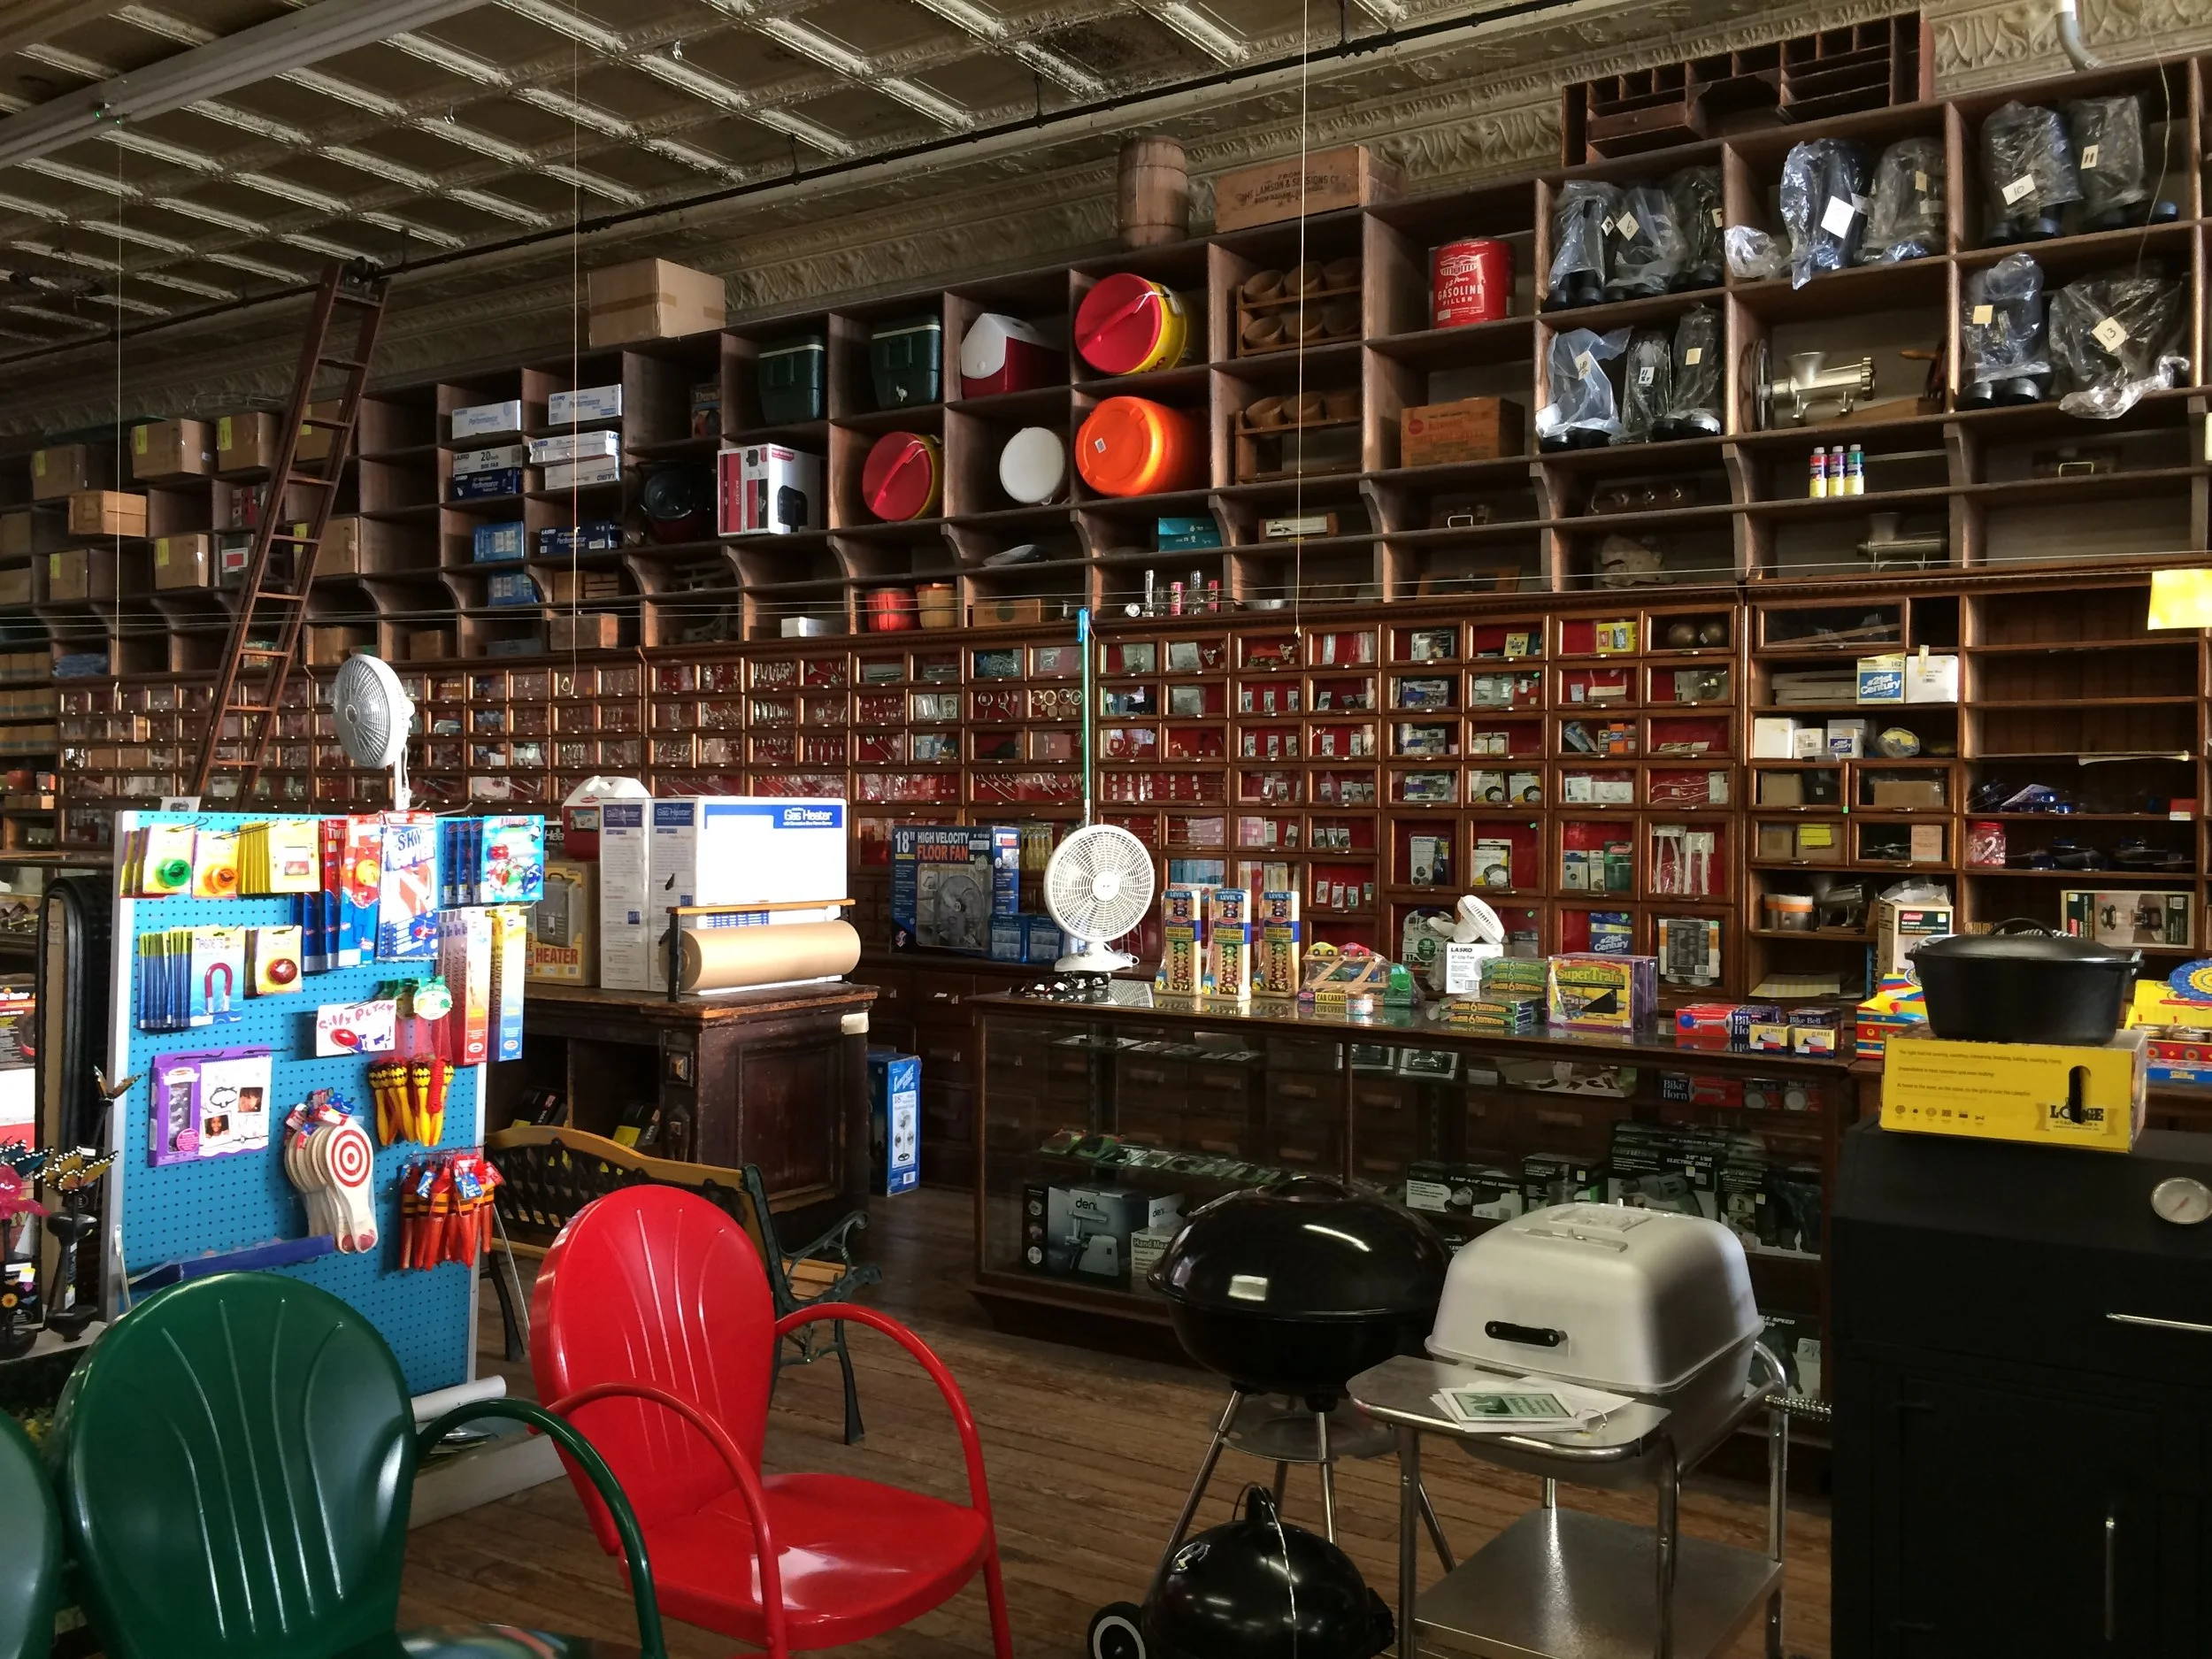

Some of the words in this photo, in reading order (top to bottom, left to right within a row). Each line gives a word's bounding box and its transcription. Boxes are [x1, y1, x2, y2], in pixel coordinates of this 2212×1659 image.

[1256, 180, 1284, 196] LAMSON
[1293, 175, 1328, 187] SESIONS
[1437, 284, 1483, 301] GASOLINE
[1442, 296, 1473, 306] FILLER
[480, 450, 491, 462] 20
[1860, 680, 1901, 695] Century
[784, 808, 802, 820] Gas
[802, 810, 833, 821] Heater
[544, 828, 565, 841] Hea
[895, 832, 916, 853] 18"
[918, 832, 934, 843] HIGH
[934, 832, 970, 844] VELOCITY
[917, 844, 948, 861] FLOOR
[949, 844, 968, 861] FAN
[1594, 940, 1629, 952] Century
[535, 948, 579, 965] HEATER
[1509, 982, 1515, 991] 6
[1327, 994, 1346, 1002] CARRI
[1471, 1002, 1478, 1011] 6
[1469, 1014, 1476, 1024] 6
[1734, 1025, 1750, 1034] Ho
[1663, 1079, 1686, 1090] Bike
[1663, 1089, 1688, 1100] Horn
[1133, 1238, 1153, 1248] Hand
